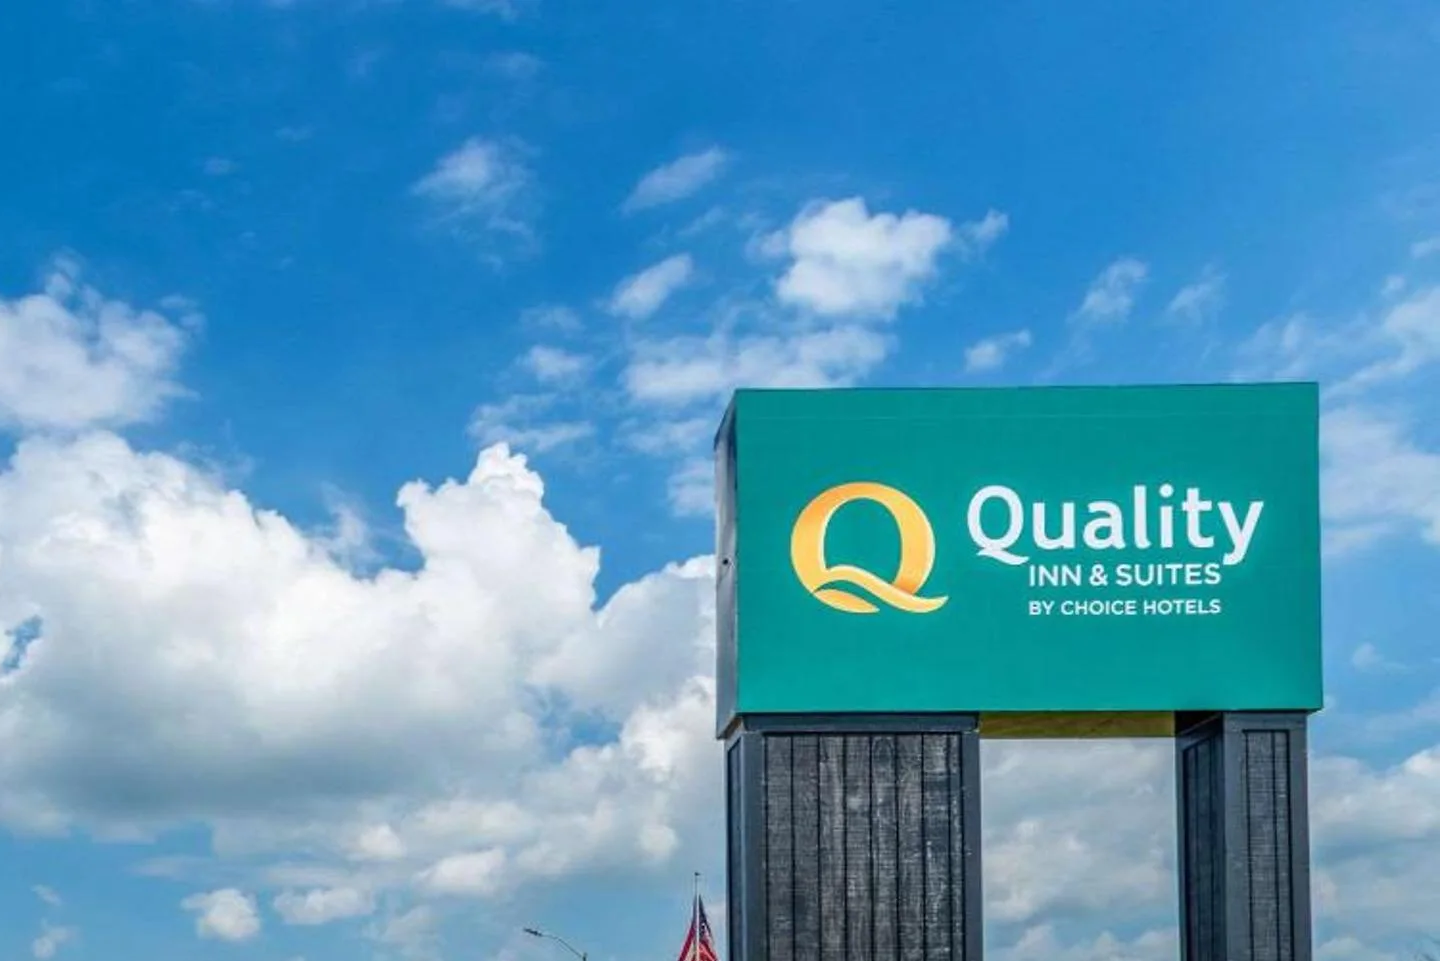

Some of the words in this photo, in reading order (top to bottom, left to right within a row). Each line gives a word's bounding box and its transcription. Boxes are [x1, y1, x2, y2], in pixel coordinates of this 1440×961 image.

[790, 481, 949, 613] Q
[966, 483, 1264, 566] Quality
[1029, 564, 1082, 587] INN
[1089, 564, 1109, 587] &
[1116, 563, 1221, 586] SUITES
[1029, 601, 1054, 616] BY
[1060, 600, 1136, 616] CHOICE
[1143, 599, 1221, 615] HOTELS
